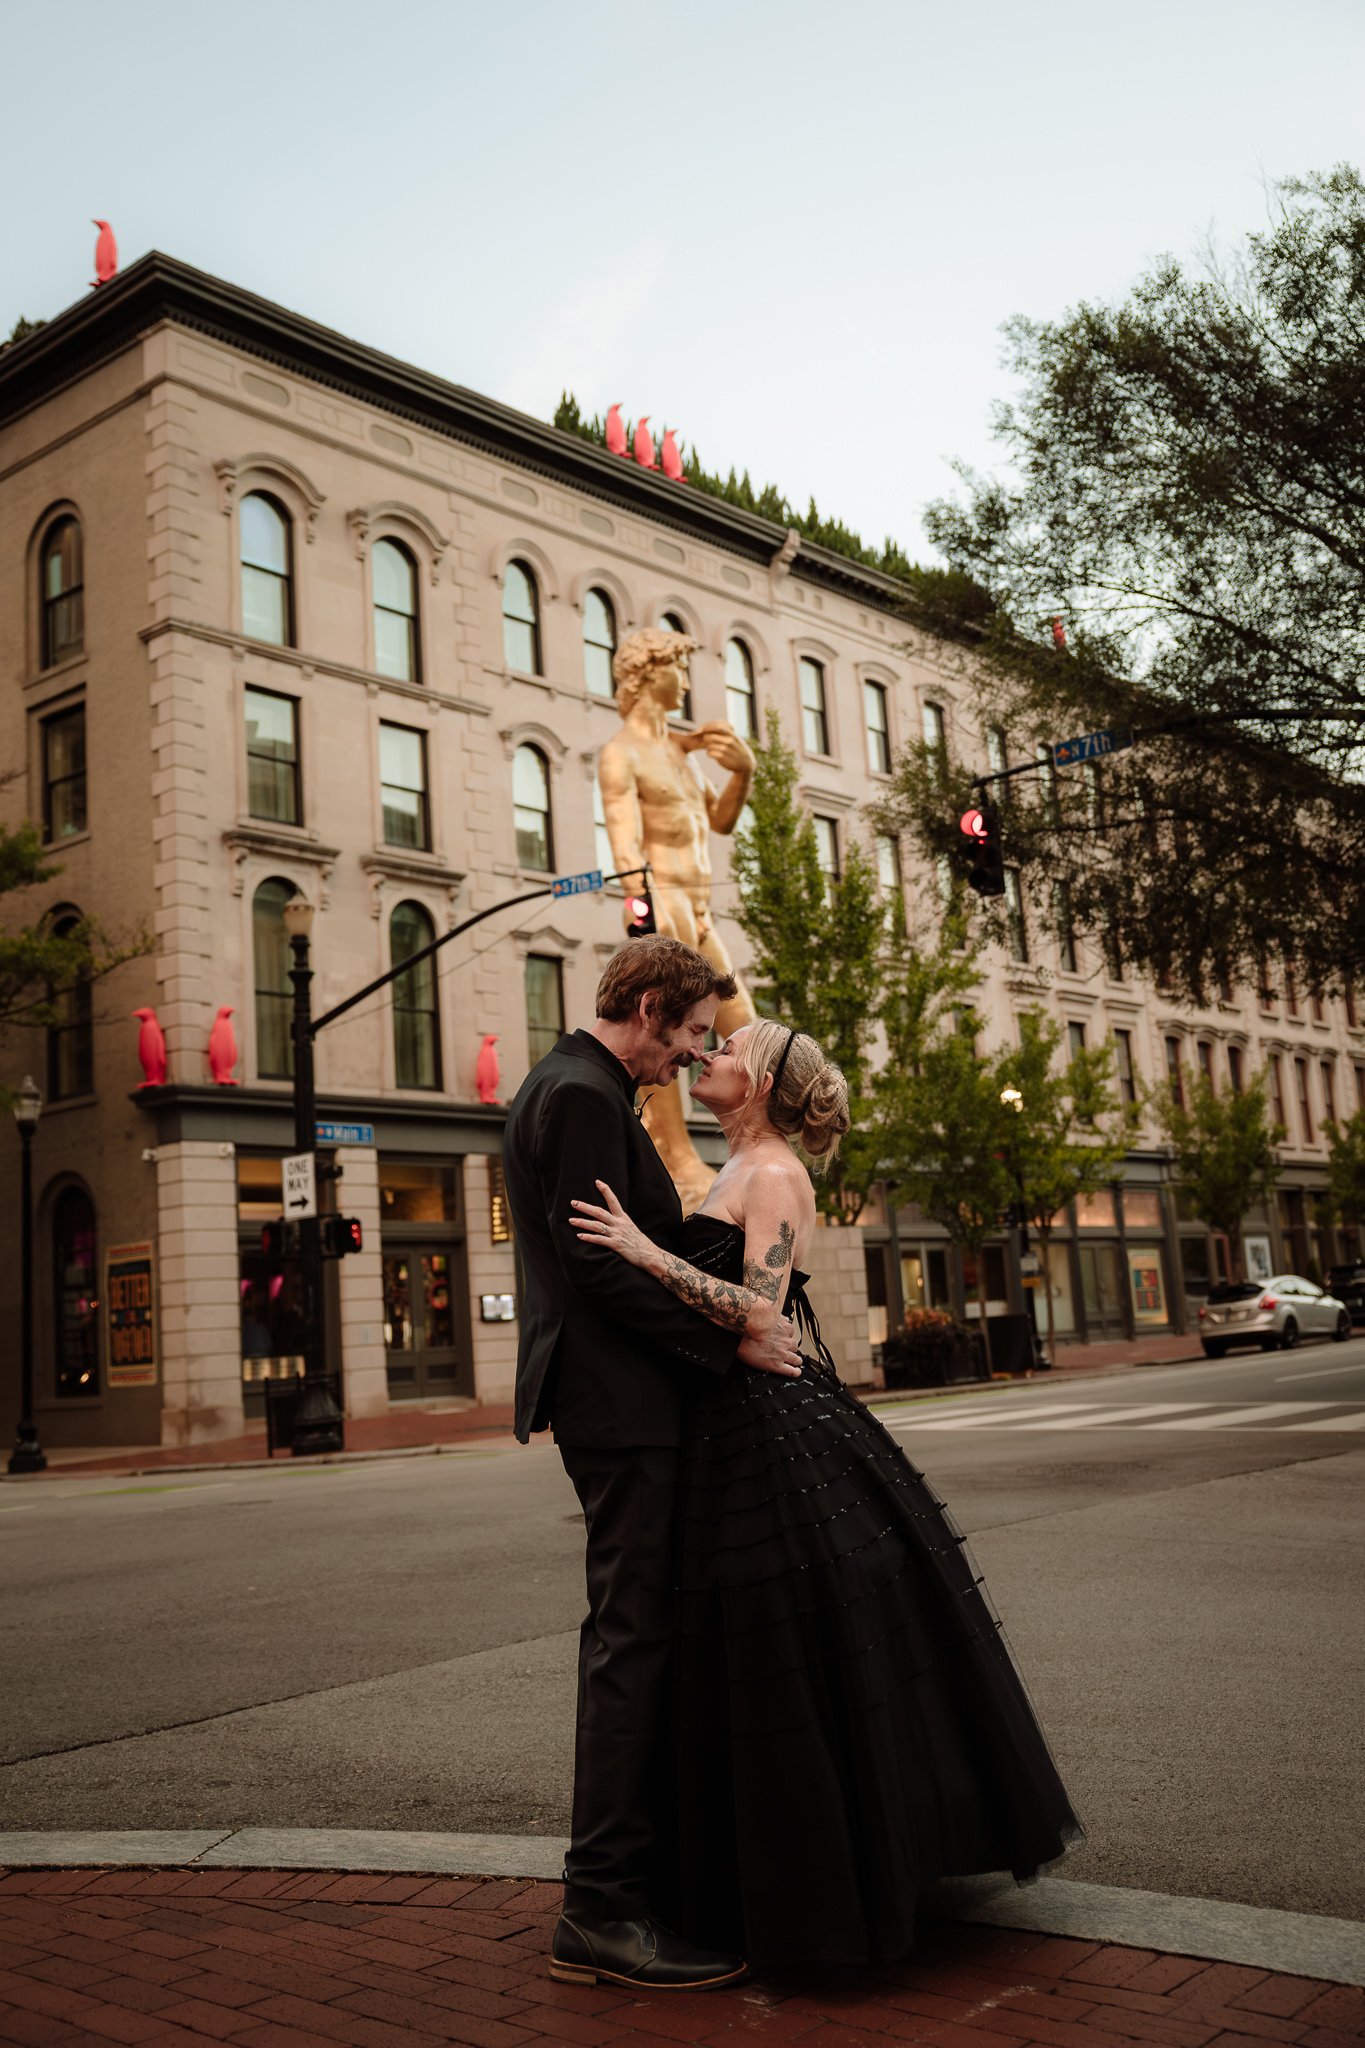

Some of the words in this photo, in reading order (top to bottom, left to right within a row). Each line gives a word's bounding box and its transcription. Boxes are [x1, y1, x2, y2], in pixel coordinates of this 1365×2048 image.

[1081, 734, 1112, 757] 7th
[569, 876, 590, 894] 7th
[334, 1126, 359, 1142] Main
[287, 1159, 308, 1175] ONE
[288, 1176, 310, 1191] WAY
